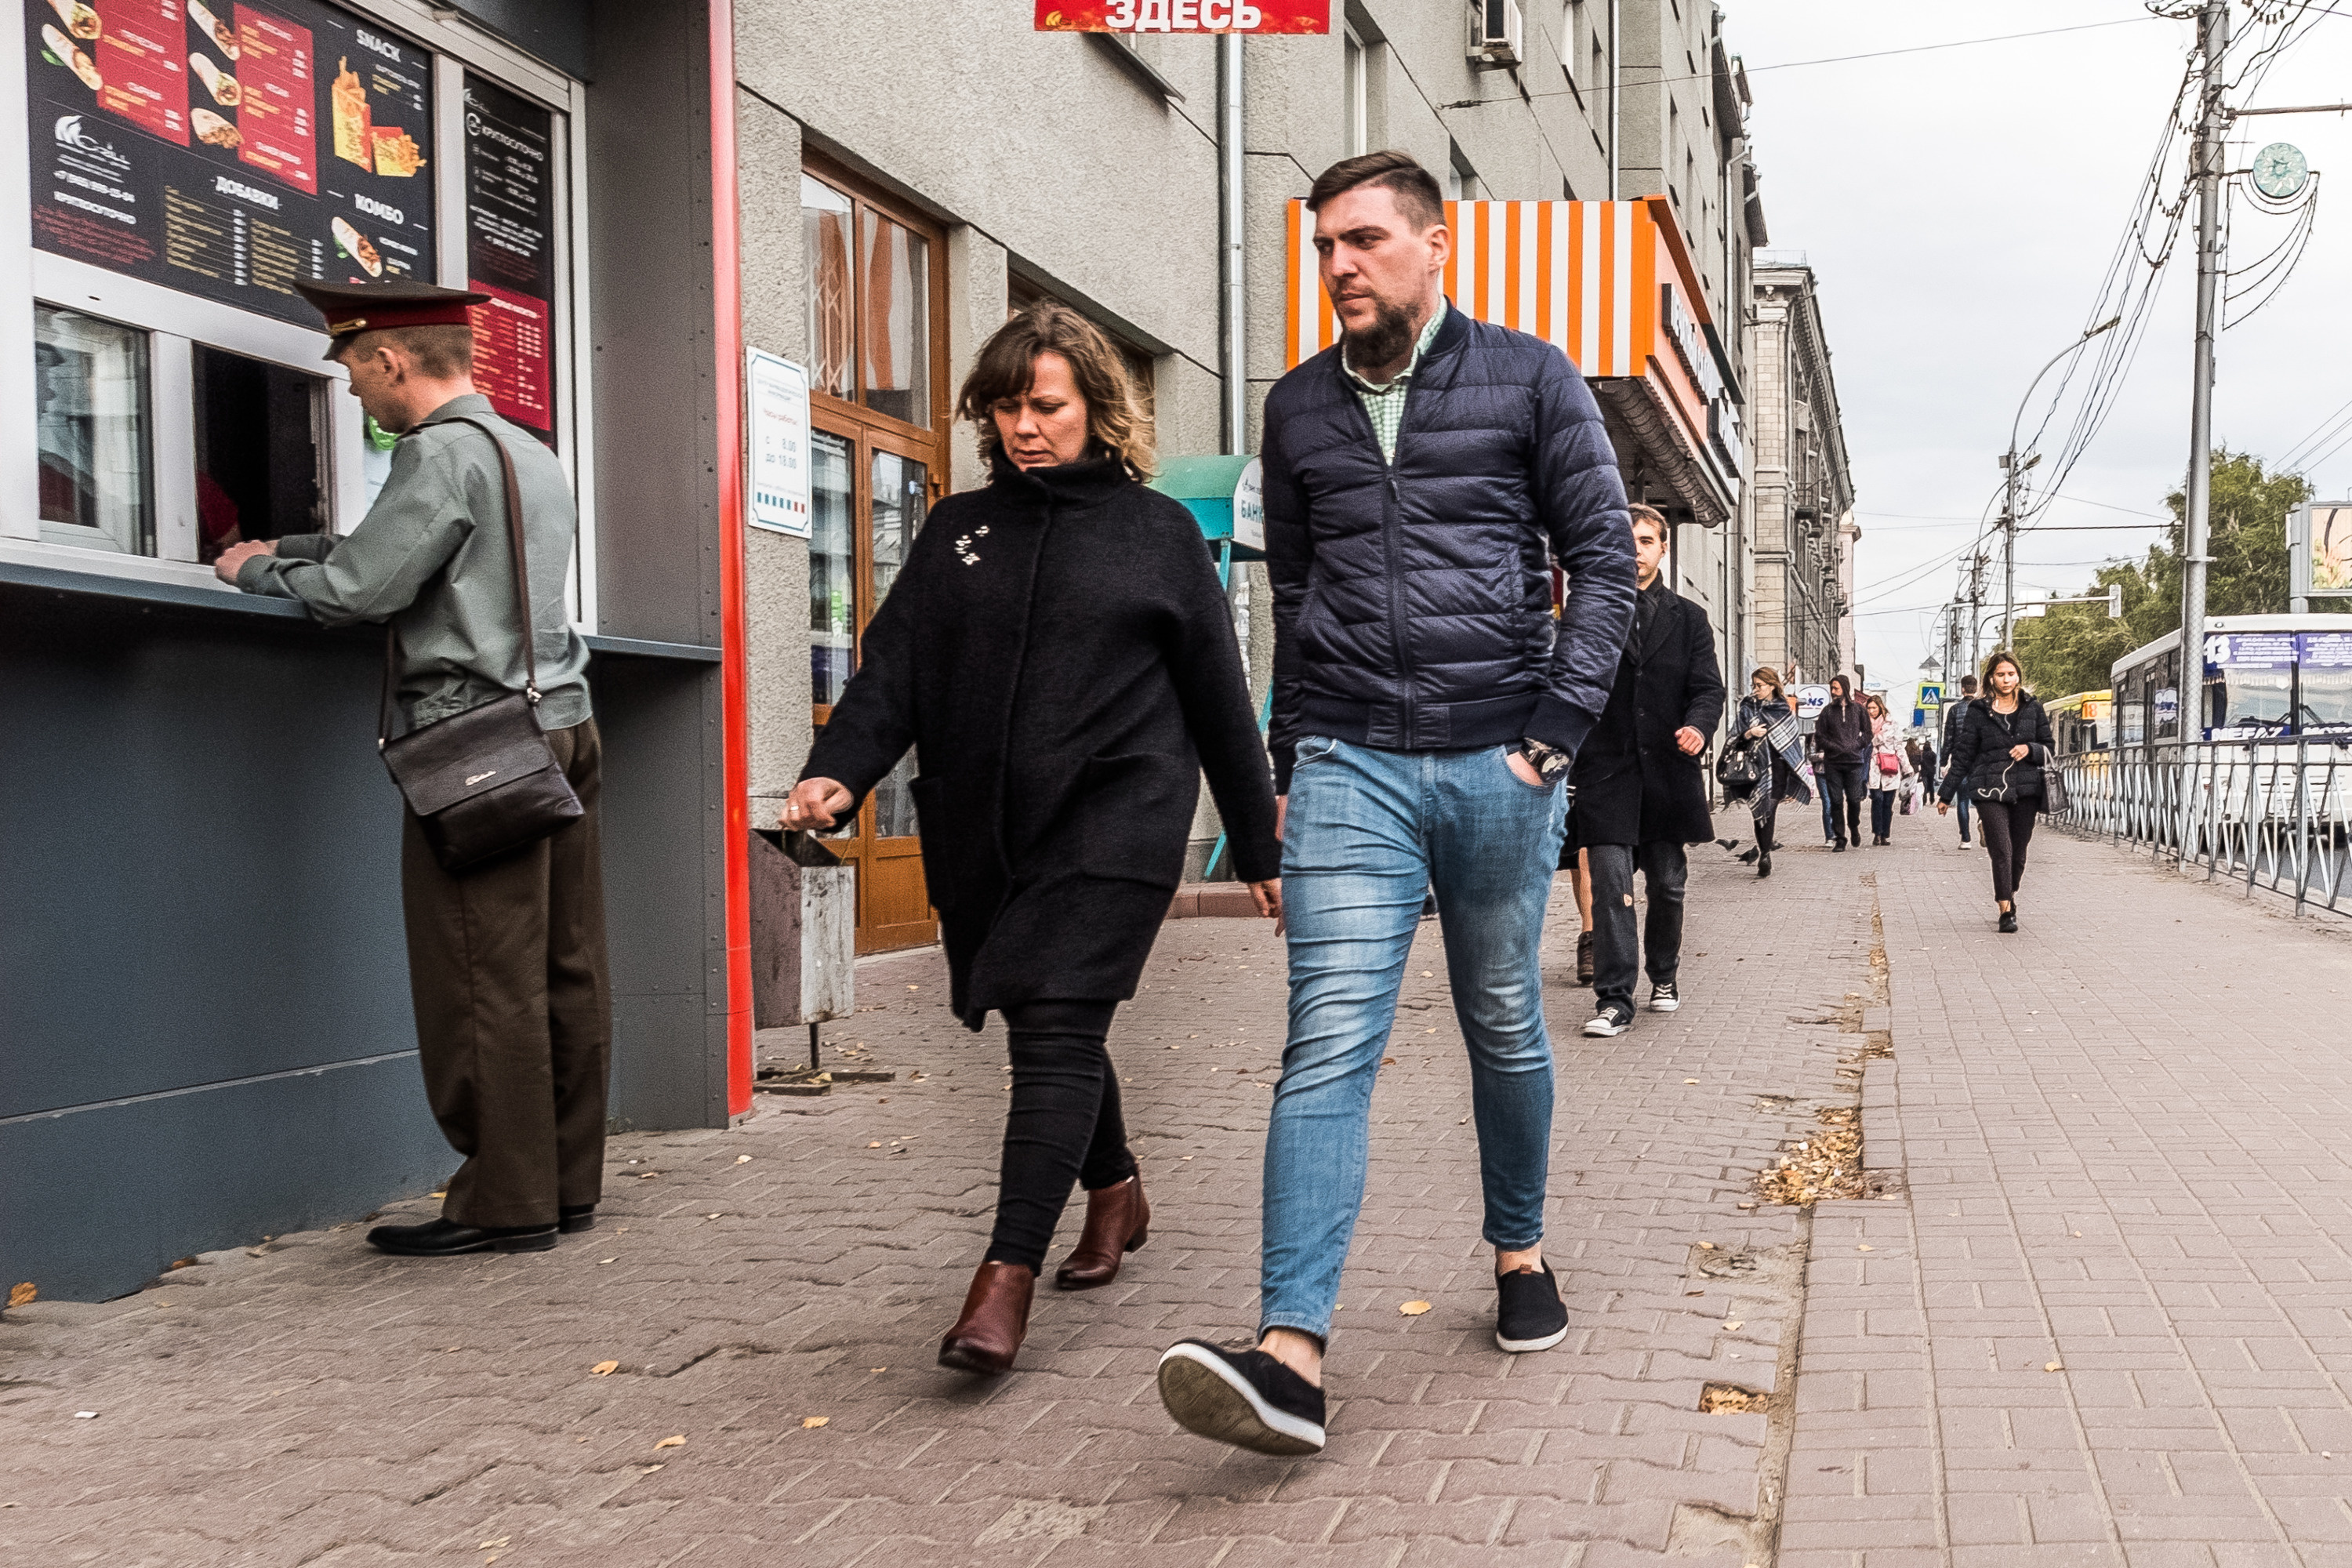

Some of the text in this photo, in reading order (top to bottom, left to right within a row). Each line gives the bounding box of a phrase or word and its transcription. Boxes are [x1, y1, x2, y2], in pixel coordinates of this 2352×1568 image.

[1105, 0, 1262, 32] ЗДЕСЬ
[356, 29, 401, 63] SNACK
[354, 194, 405, 225] КОМБО
[2082, 702, 2098, 718] 18
